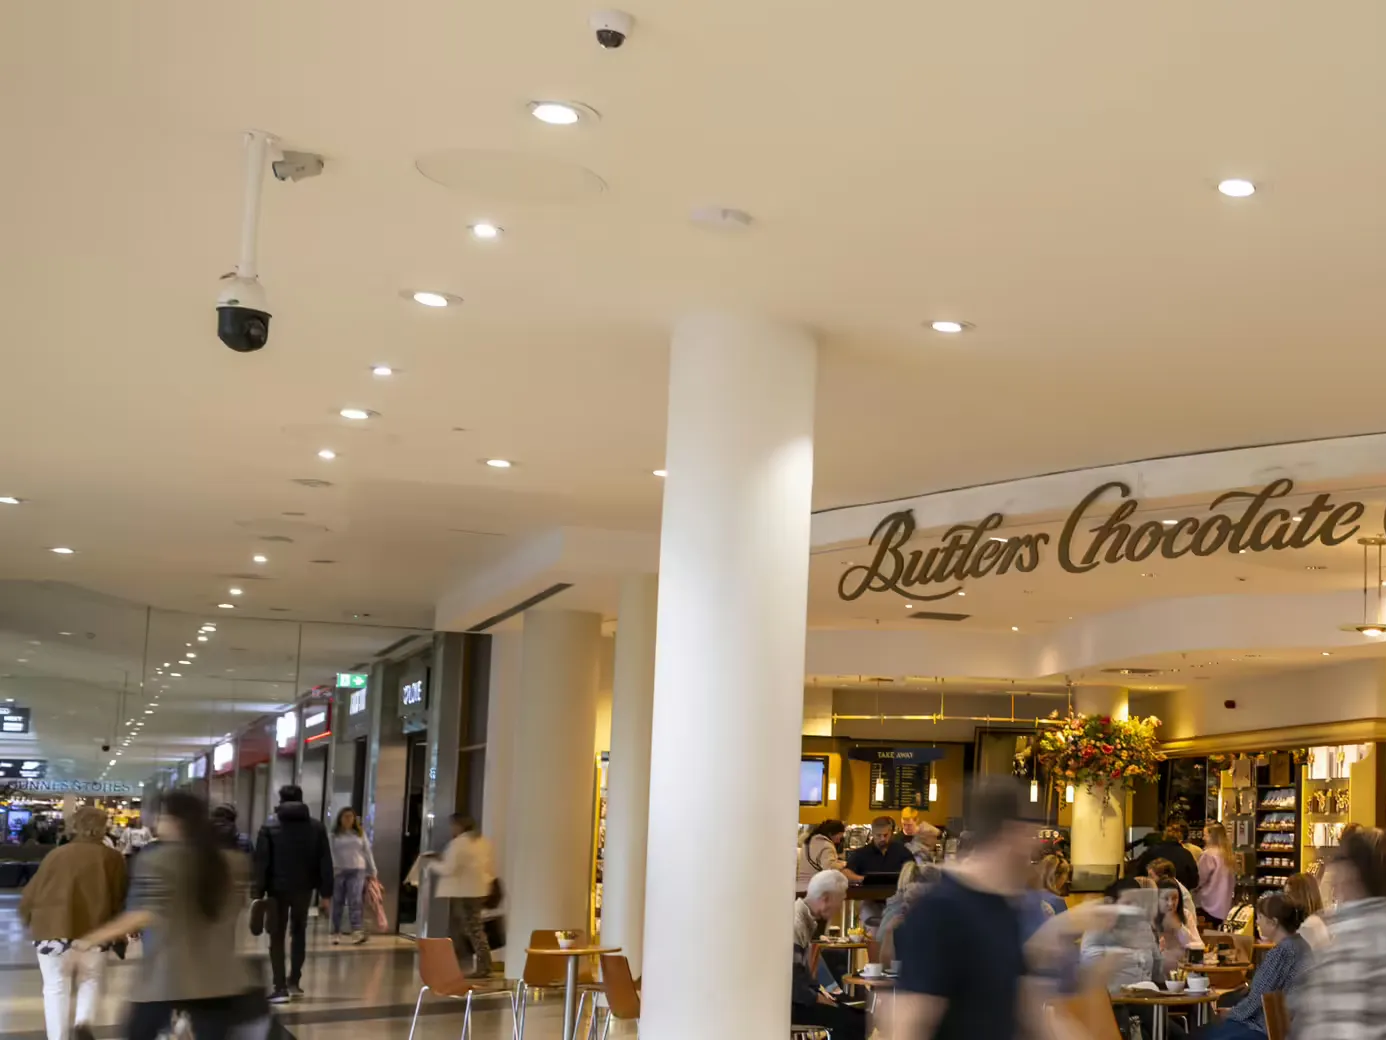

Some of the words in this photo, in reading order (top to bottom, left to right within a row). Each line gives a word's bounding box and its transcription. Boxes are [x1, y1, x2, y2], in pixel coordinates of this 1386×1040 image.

[838, 508, 1050, 602] Butlers
[1058, 478, 1366, 573] Chocolate
[877, 751, 895, 759] TAKE
[896, 751, 914, 759] AWAY
